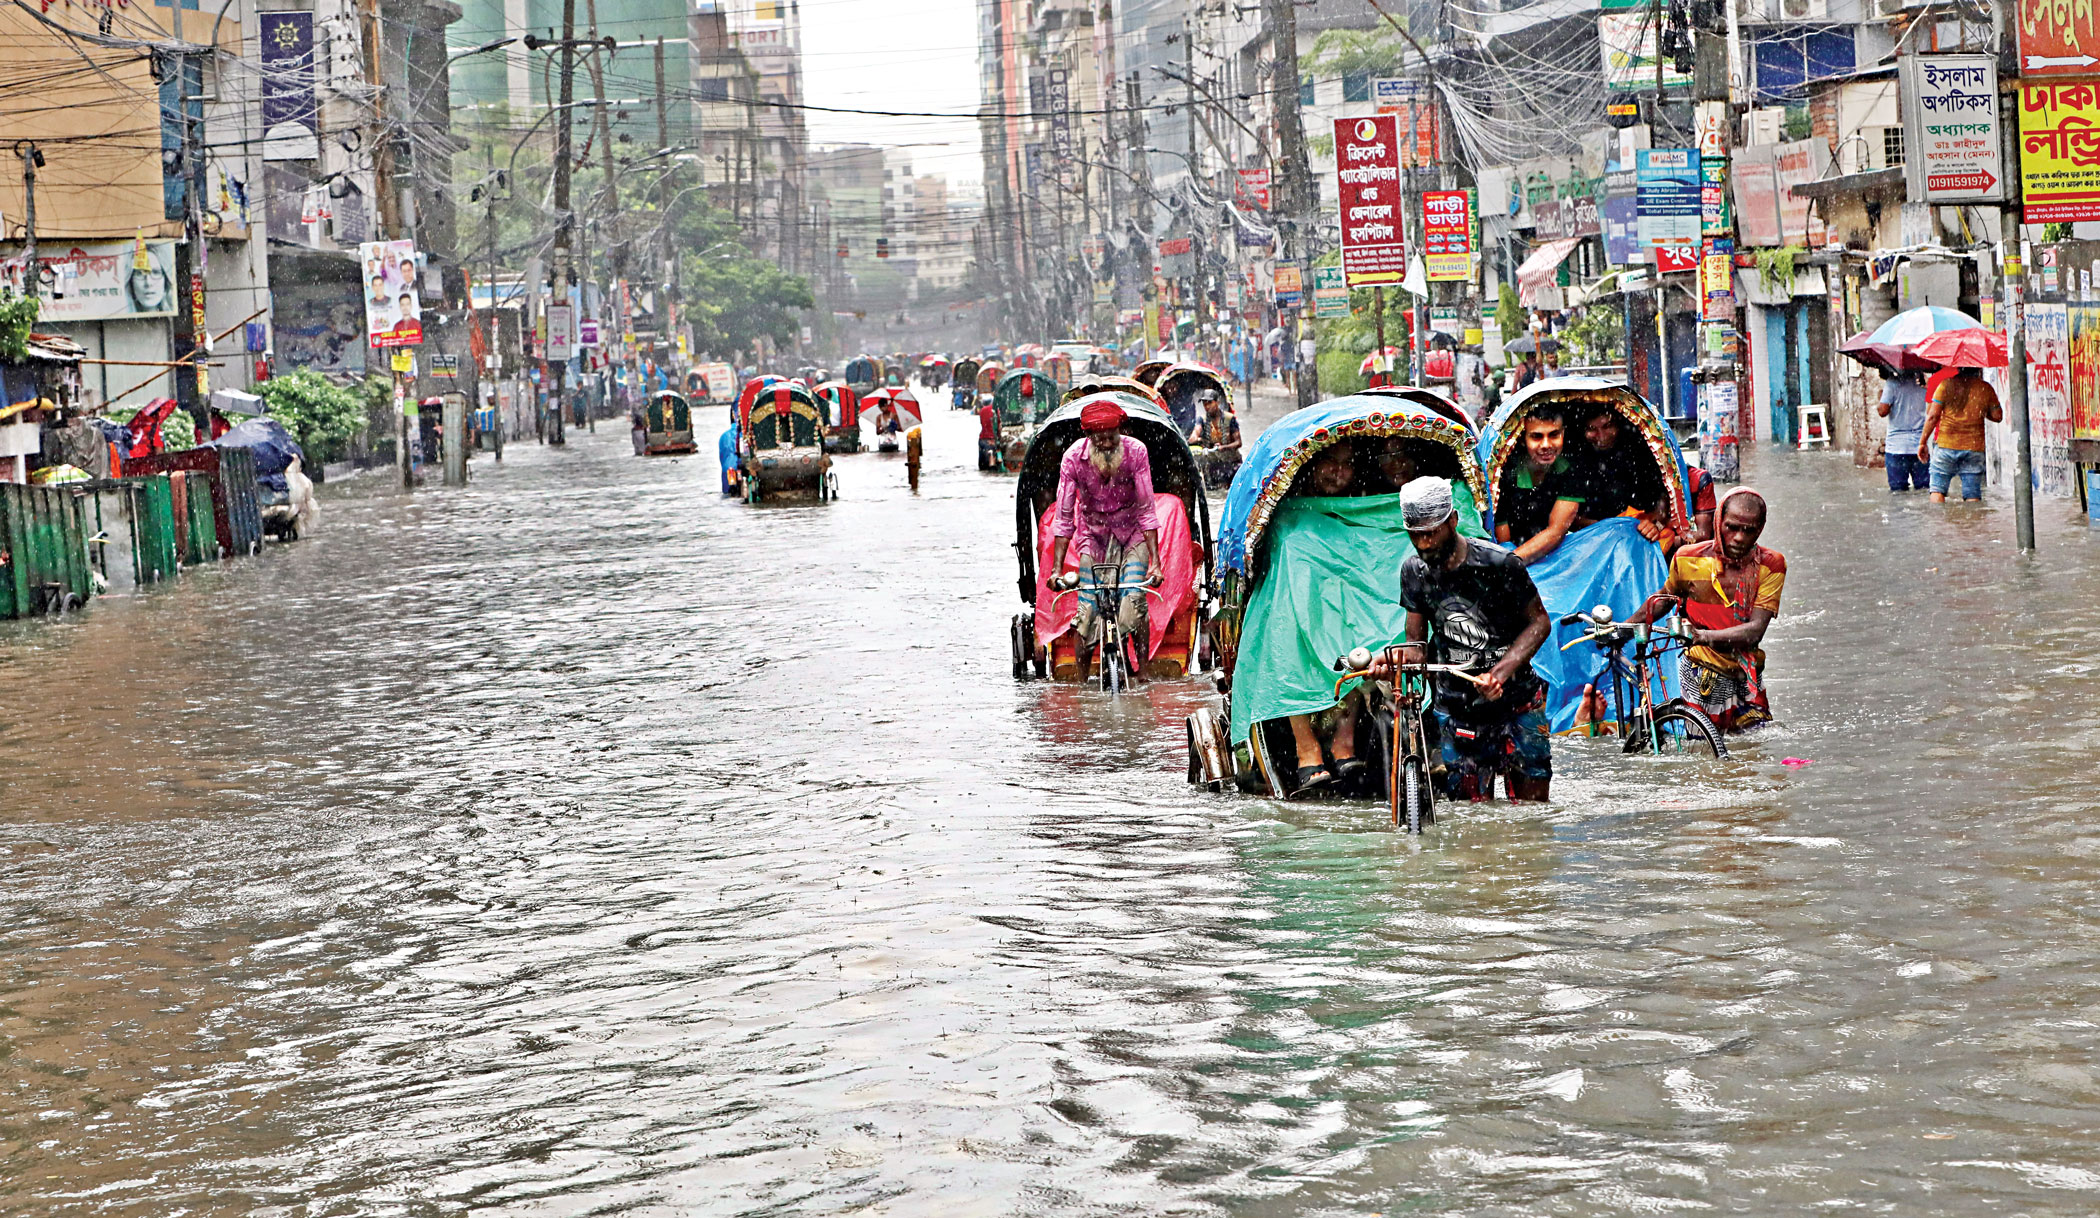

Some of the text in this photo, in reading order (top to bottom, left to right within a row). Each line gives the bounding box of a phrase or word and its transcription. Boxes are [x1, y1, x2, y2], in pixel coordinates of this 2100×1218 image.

[1924, 63, 1986, 90] ইসলাম
[1921, 89, 1992, 116] অপটিকস্
[2023, 83, 2100, 112] ঢাকা
[1926, 123, 1991, 136] অধ্যাপক
[1346, 142, 1386, 161] ক্রিসেন্ট
[1935, 141, 1949, 149] ডাঃ
[1926, 150, 1995, 160] আহসান (মেনন)
[1929, 176, 1990, 188] 01911591974
[1350, 204, 1392, 221] জেনারেল
[1426, 196, 1464, 213] গাড়ী
[1426, 213, 1465, 227] ভাড়া
[1349, 223, 1394, 243] হসপিটাল
